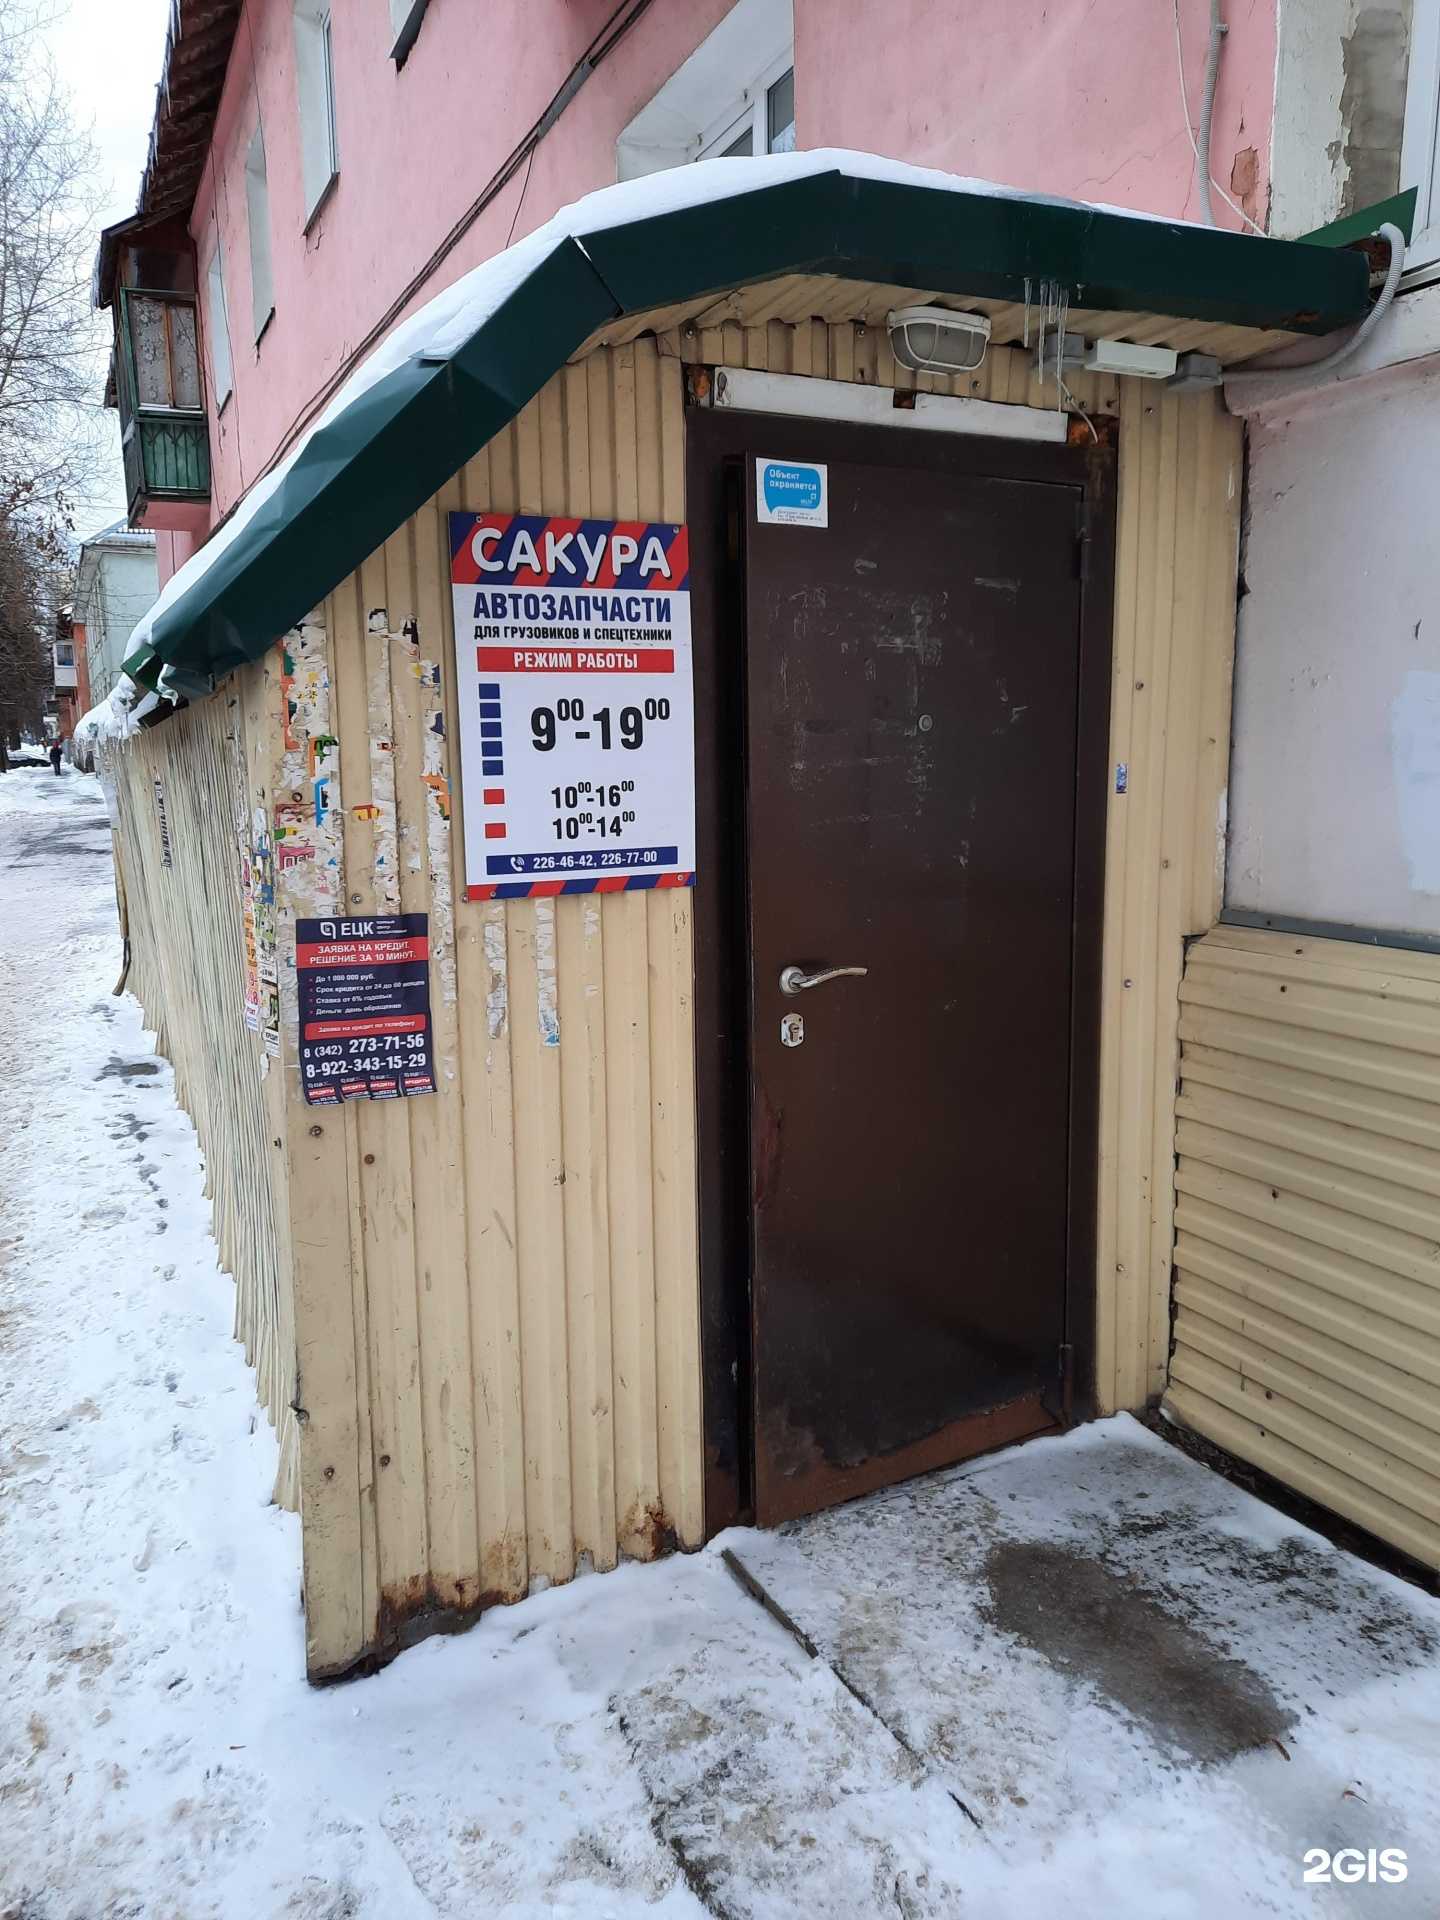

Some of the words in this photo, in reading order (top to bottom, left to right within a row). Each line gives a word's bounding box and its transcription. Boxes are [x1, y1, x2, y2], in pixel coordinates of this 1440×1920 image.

[471, 527, 673, 583] САКУРА
[473, 592, 672, 623] АВТОЗАПЧАСТИ
[474, 625, 500, 640] ДЛЯ
[503, 625, 580, 640] ГРУЗОВИКОВ
[583, 627, 591, 640] И
[594, 628, 672, 642] СПЕЦТЕХНИКИ
[513, 651, 573, 669] РЕЖИМ
[577, 652, 638, 669] РАБОТЫ
[533, 854, 598, 869] 226-46-42,
[601, 850, 658, 866] 226-77-00
[341, 921, 375, 938] ЕЦК
[318, 943, 356, 954] ЗАЯВКА
[358, 943, 372, 952] НА
[374, 941, 409, 951] КРЕДИТ
[309, 954, 357, 964] РЕШЕНИЕ
[359, 954, 373, 962] ЗА
[375, 953, 384, 961] 10
[315, 986, 334, 994] Срок
[303, 1048, 311, 1058] 8
[314, 1045, 343, 1058] (342)
[348, 1033, 425, 1054] 273-71-56
[305, 1053, 427, 1079] 8-922-343-15-29
